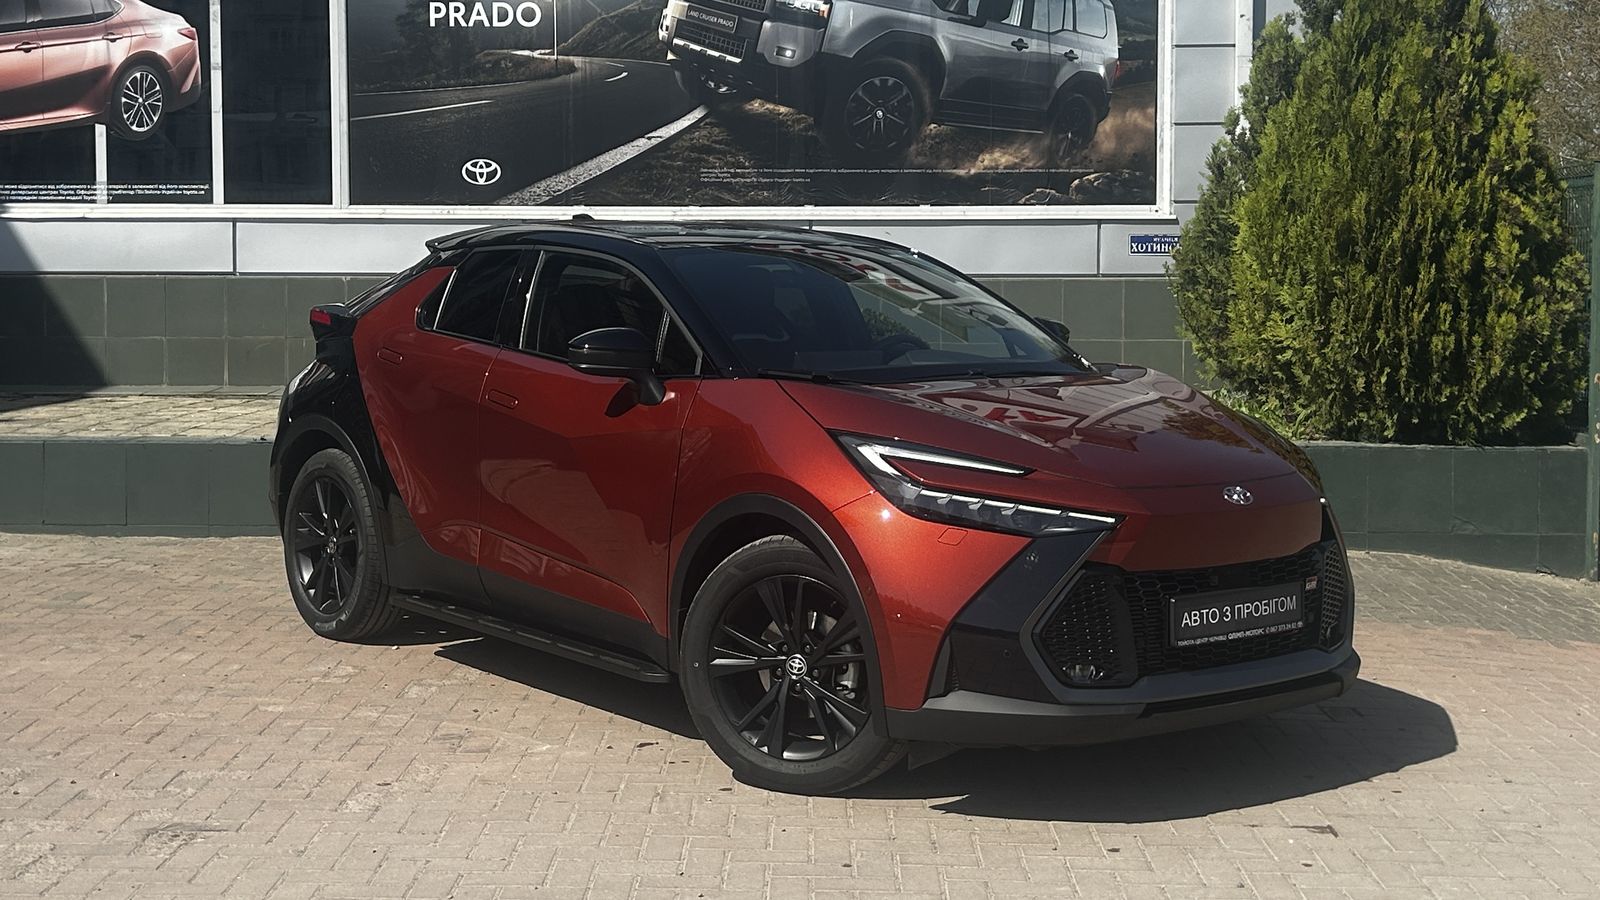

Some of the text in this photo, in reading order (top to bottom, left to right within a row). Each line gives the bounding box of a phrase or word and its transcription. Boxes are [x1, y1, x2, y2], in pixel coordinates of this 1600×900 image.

[429, 1, 542, 27] PRADO
[688, 10, 734, 27] LAND CRUISER PRADO
[1181, 608, 1220, 627] АВТО
[1234, 595, 1297, 620] ПРОБІГОМ
